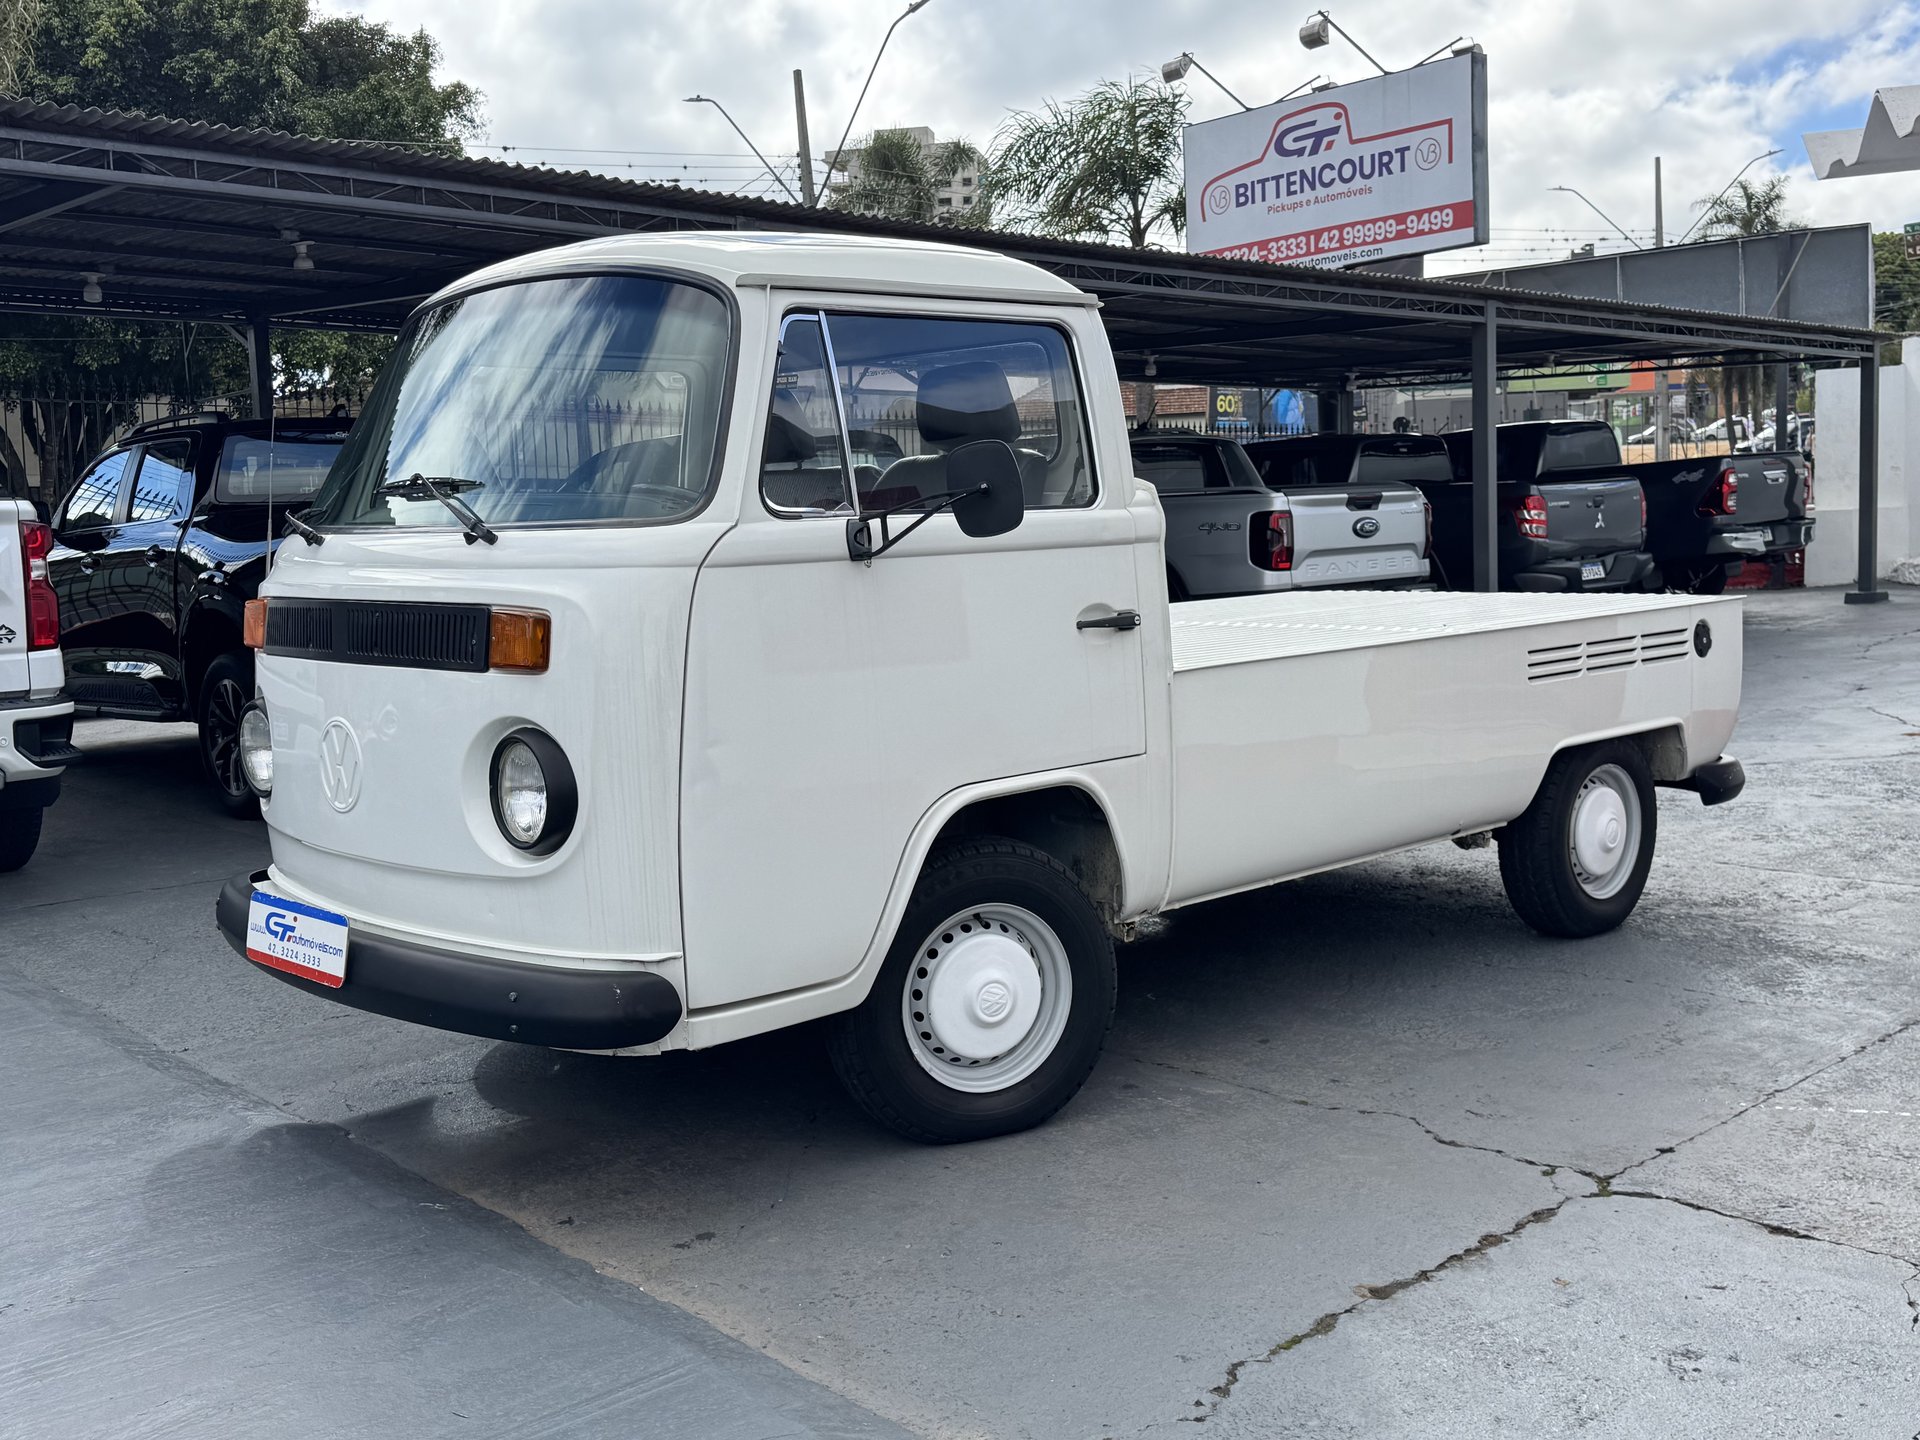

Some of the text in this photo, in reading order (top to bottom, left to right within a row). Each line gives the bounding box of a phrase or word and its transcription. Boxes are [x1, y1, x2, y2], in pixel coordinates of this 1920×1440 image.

[1235, 145, 1411, 208] BITTENCOURT
[1267, 184, 1373, 215] Pickups e Automóveis
[1318, 229, 1340, 250] 42
[1343, 208, 1453, 246] 99999-9499
[1306, 555, 1416, 577] RANGER
